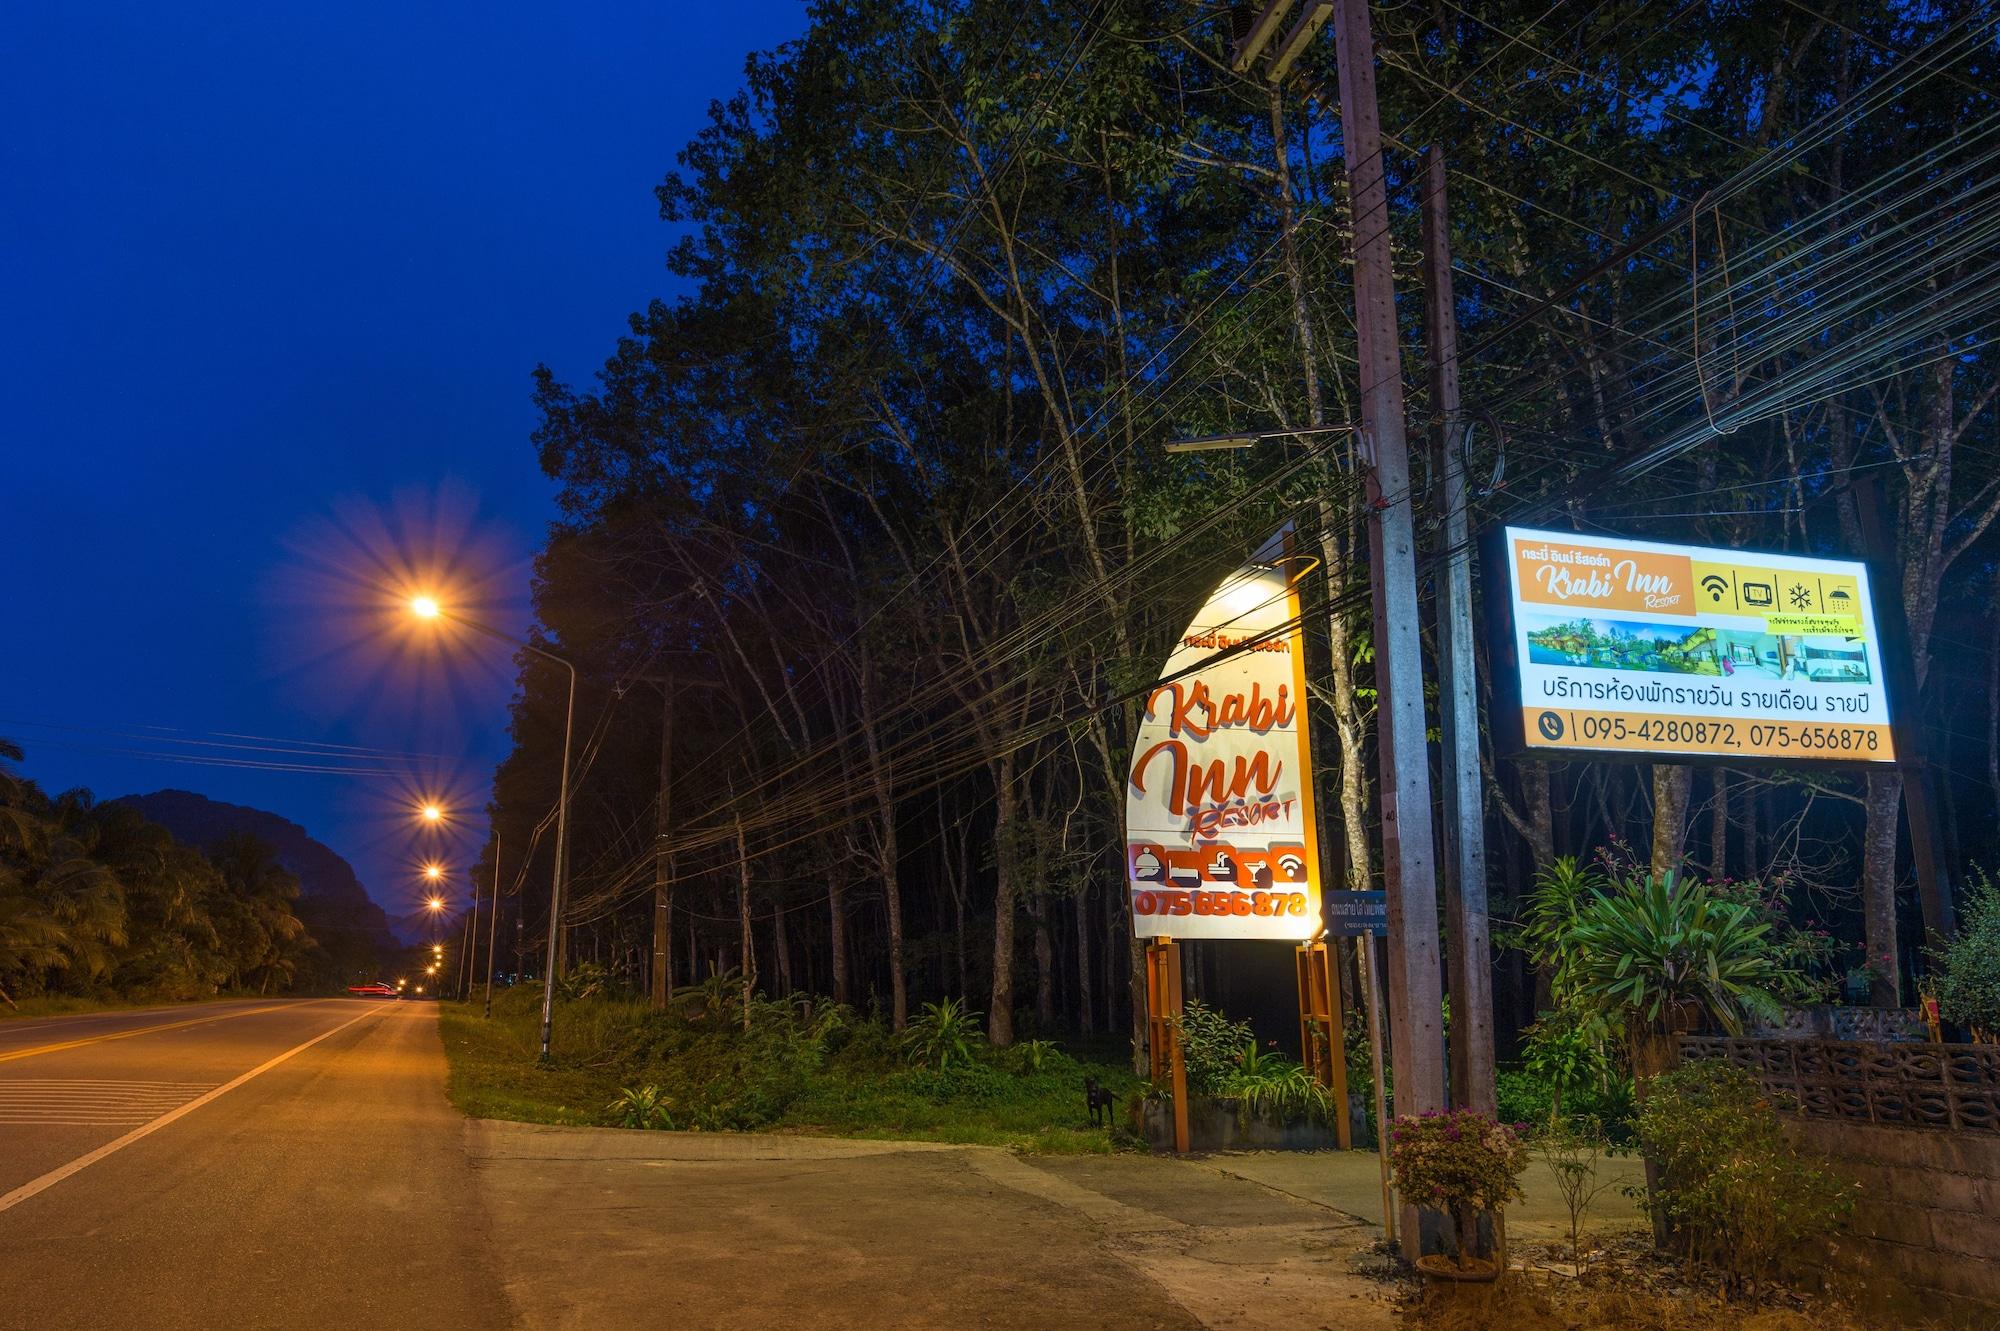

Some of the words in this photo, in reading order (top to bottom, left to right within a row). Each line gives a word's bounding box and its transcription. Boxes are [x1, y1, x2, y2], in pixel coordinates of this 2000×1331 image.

[1522, 545, 1549, 561] กระบี่
[1536, 565, 1613, 599] Krabi
[1614, 559, 1673, 595] Inn
[1147, 680, 1295, 737] Krabi
[1543, 676, 1733, 707] บริการห้องพักรายวัน
[1741, 688, 1817, 711] รายเดือน
[1826, 692, 1869, 713] รายปี
[1583, 716, 1741, 748] 095-4280872,
[1750, 725, 1878, 751] 075-656878
[1129, 740, 1282, 816] Inn
